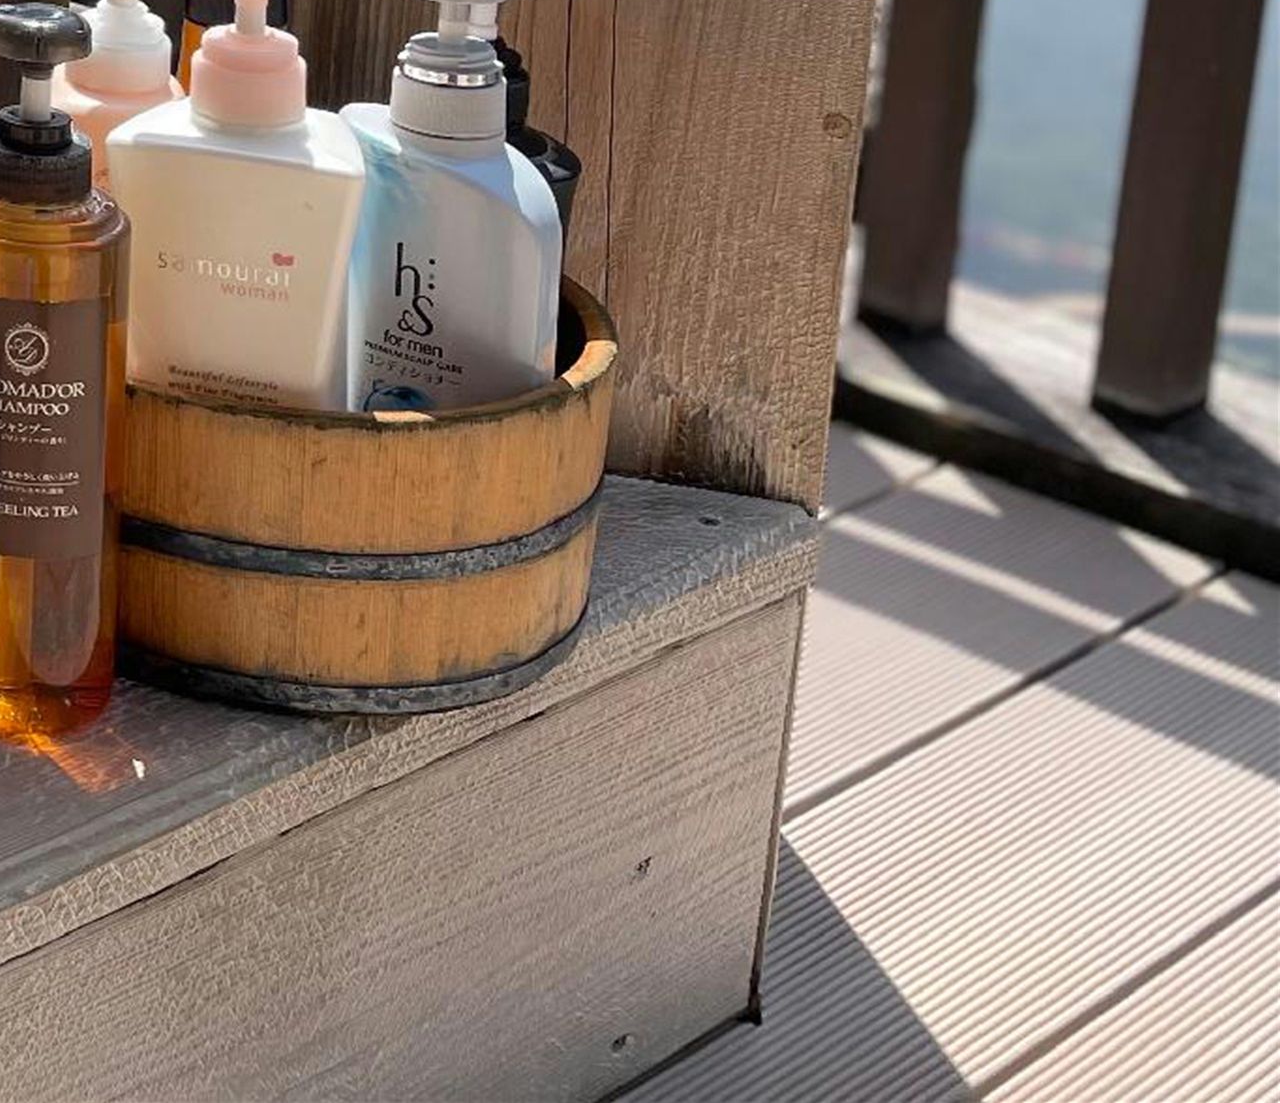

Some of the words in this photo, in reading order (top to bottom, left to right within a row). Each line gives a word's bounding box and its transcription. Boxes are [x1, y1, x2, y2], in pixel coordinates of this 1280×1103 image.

[220, 282, 290, 302] woman
[383, 328, 405, 348] for
[407, 339, 444, 359] men
[364, 353, 462, 385] コンディショナー
[436, 361, 464, 375] CARE
[51, 503, 80, 518] TEA
